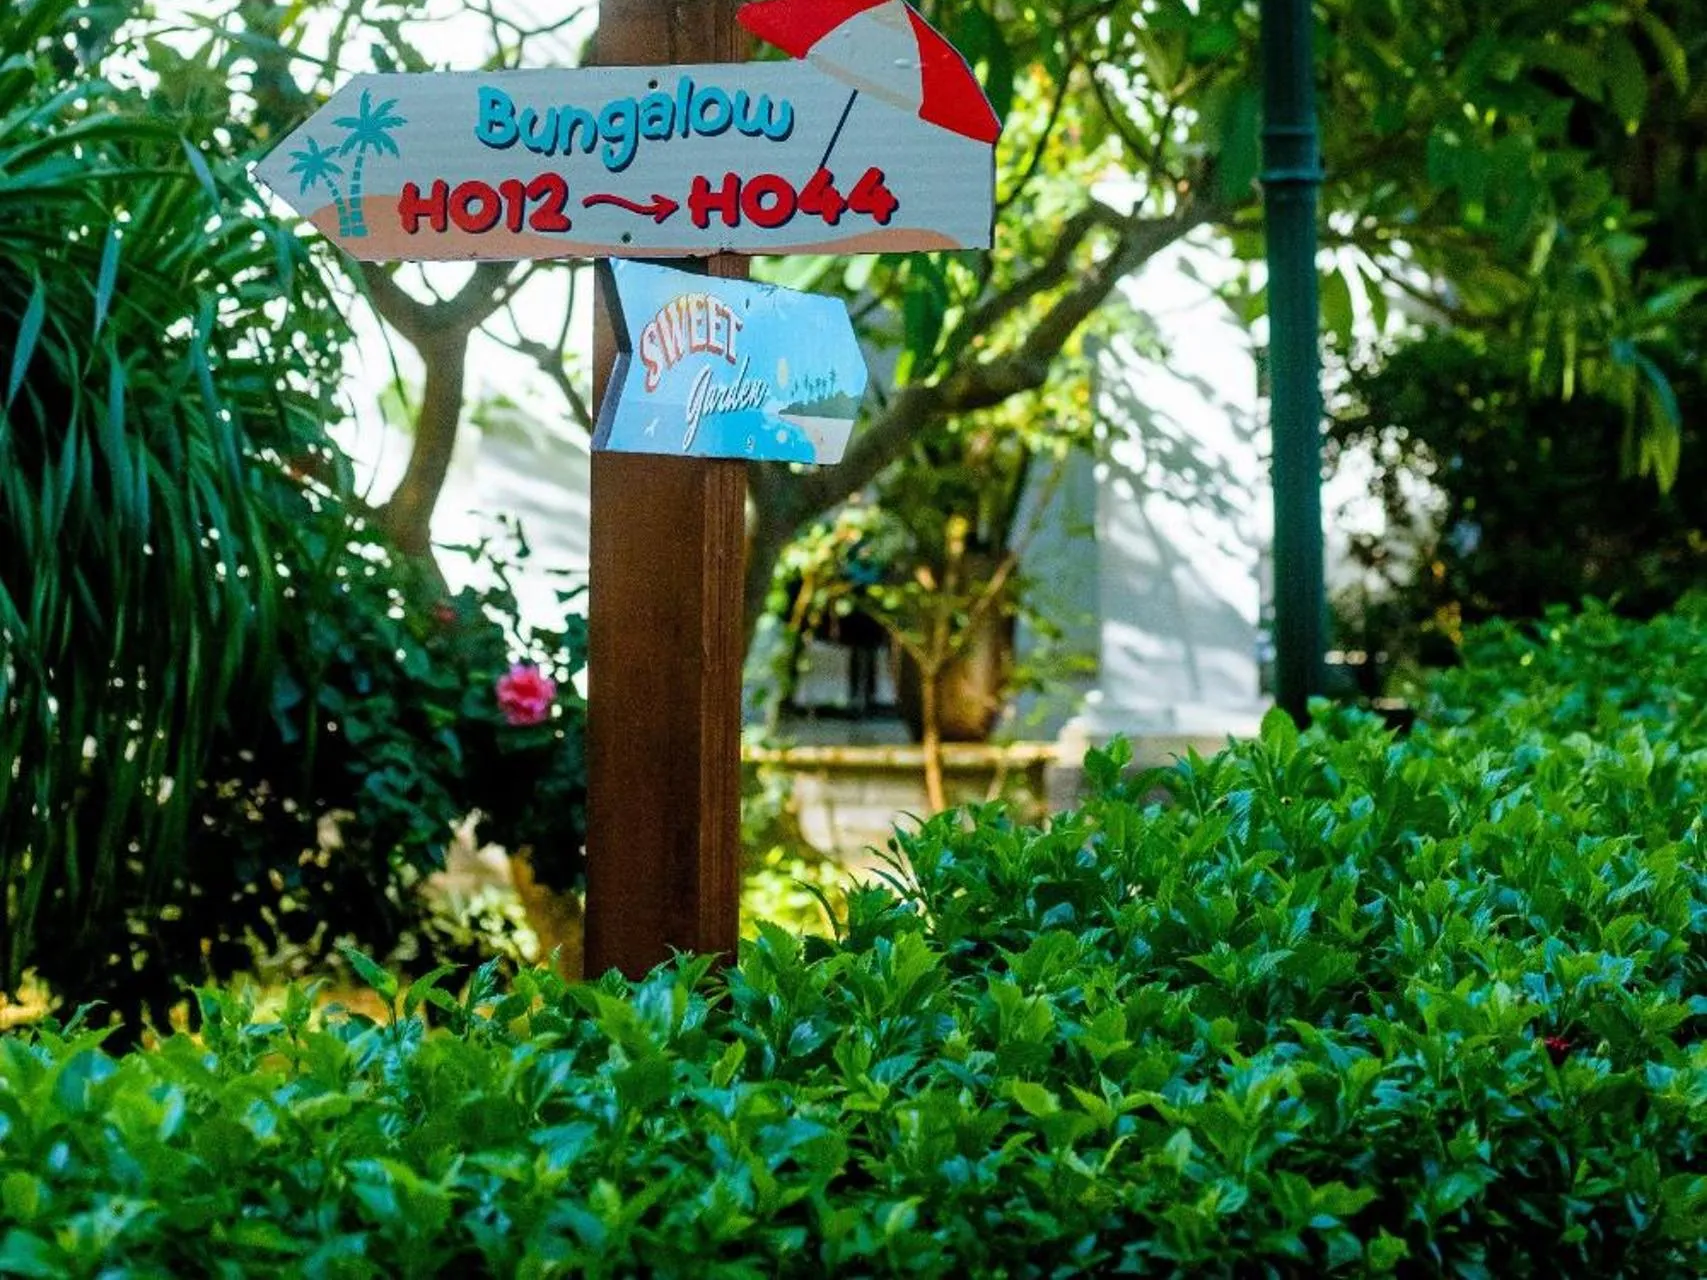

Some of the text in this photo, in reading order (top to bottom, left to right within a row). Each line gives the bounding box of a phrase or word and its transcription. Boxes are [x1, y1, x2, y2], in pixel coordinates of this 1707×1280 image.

[474, 75, 795, 173] Bungalow
[640, 291, 744, 393] SWEET
[683, 353, 769, 451] Garden
